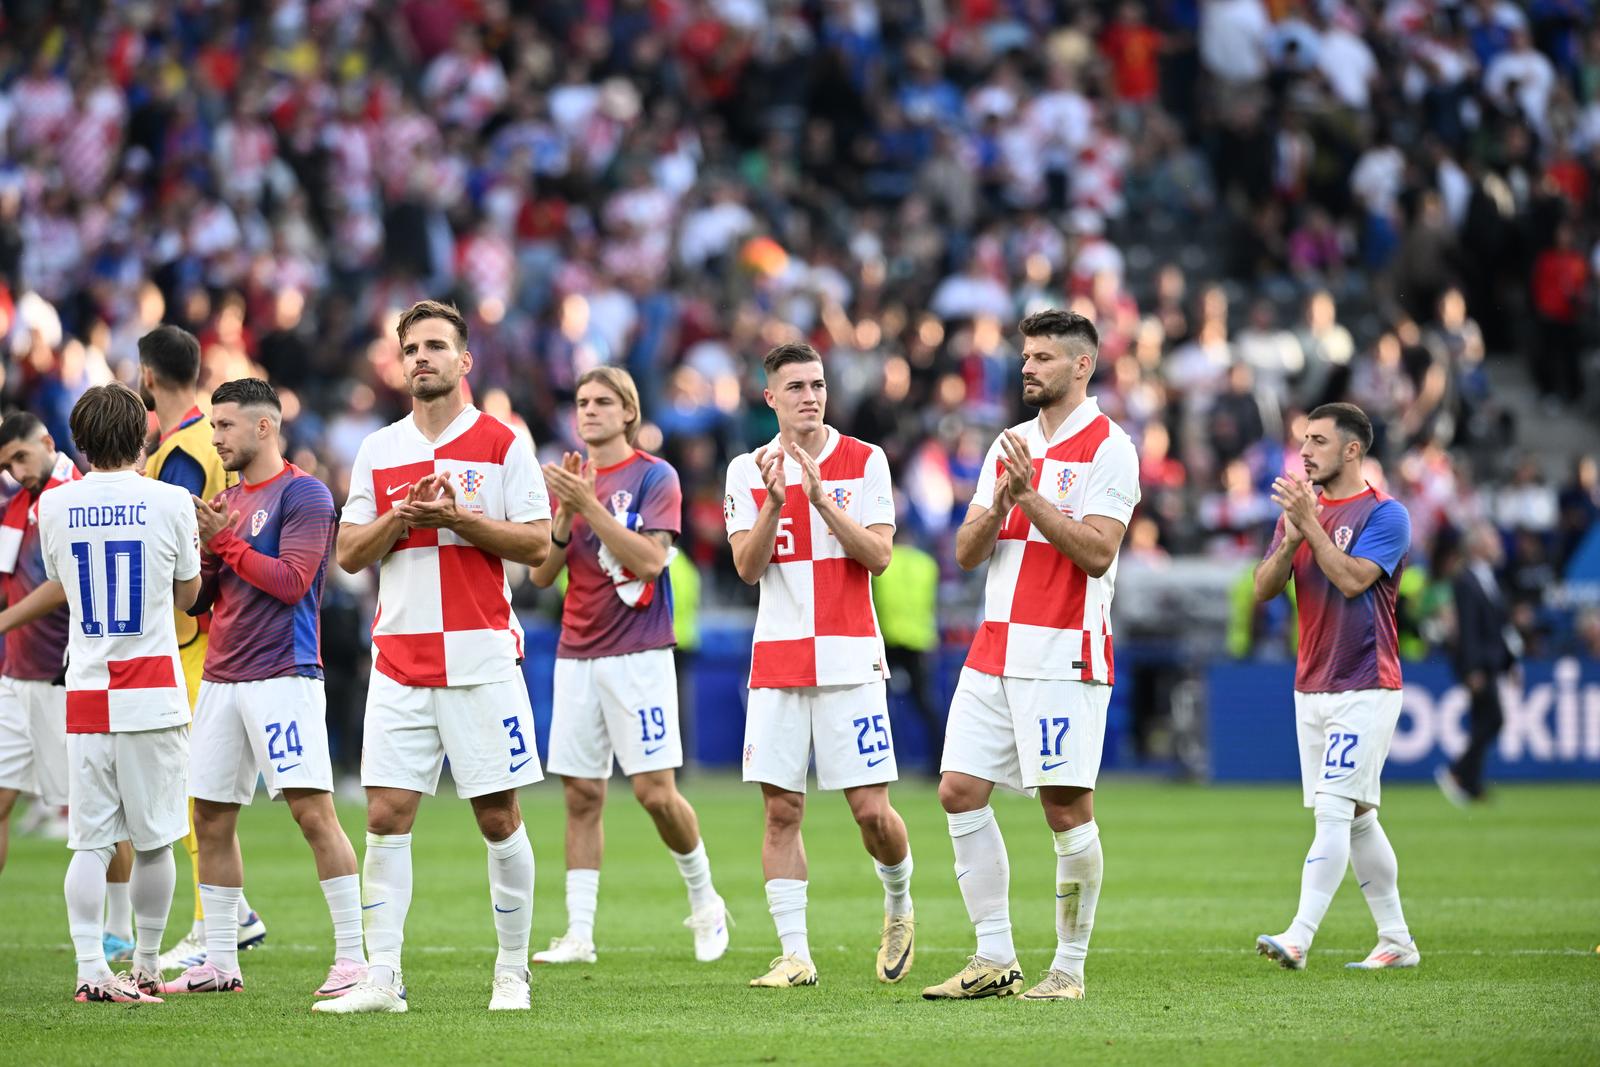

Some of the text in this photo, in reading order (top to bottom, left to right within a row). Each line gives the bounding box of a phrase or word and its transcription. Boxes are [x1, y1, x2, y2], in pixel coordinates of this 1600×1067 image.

[69, 501, 147, 528] MODRIĆ
[776, 517, 795, 557] 5
[71, 540, 146, 638] 10
[264, 720, 304, 761] 24
[502, 715, 528, 758] 3
[638, 706, 666, 743] 19
[853, 714, 891, 756] 25
[1038, 717, 1071, 757] 17
[1325, 732, 1359, 769] 22
